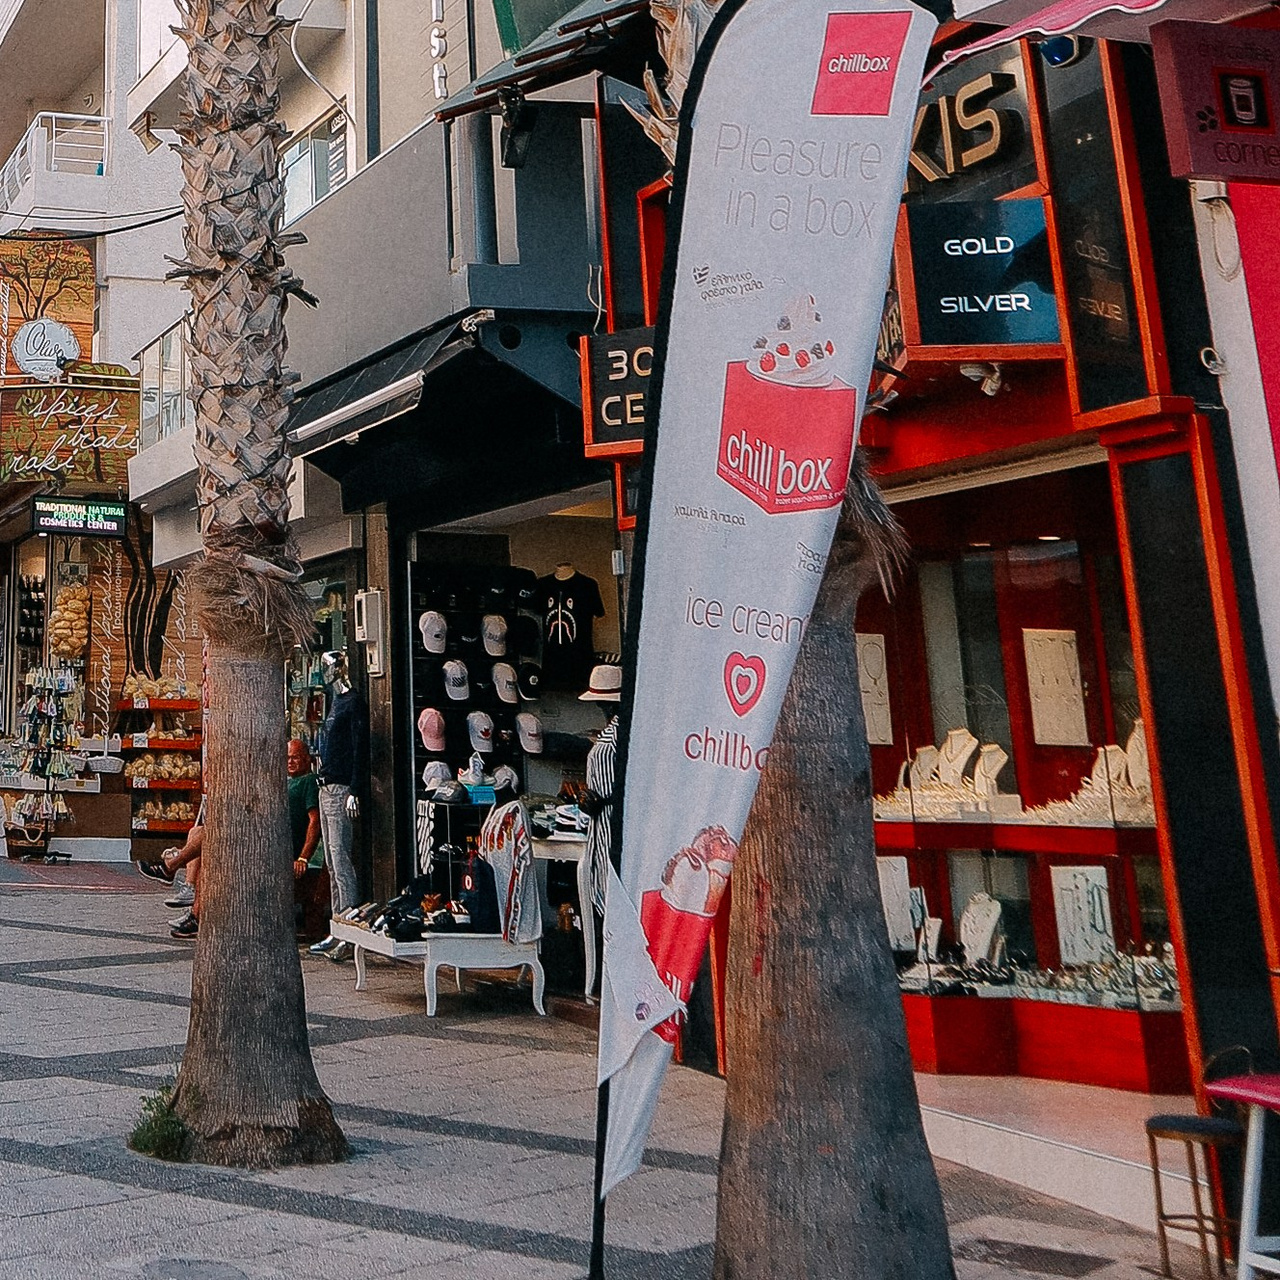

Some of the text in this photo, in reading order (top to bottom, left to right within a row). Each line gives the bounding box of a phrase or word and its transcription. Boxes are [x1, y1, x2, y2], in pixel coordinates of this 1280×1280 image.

[827, 53, 891, 74] chillbox
[713, 122, 882, 181] Pleasure
[1212, 141, 1280, 167] corne
[725, 177, 879, 239] in a box
[943, 236, 1015, 256] GOLD
[939, 293, 1032, 314] SILVER
[29, 389, 119, 429] spices
[9, 434, 78, 473] raki
[725, 429, 774, 491] chill
[776, 450, 833, 495] box
[35, 502, 125, 517] TRADITIONAL NATURAL
[40, 517, 118, 531] COSMETICS CENTER
[53, 511, 96, 522] PRODUCTS
[685, 587, 723, 629] ice
[684, 726, 770, 772] chillbo
